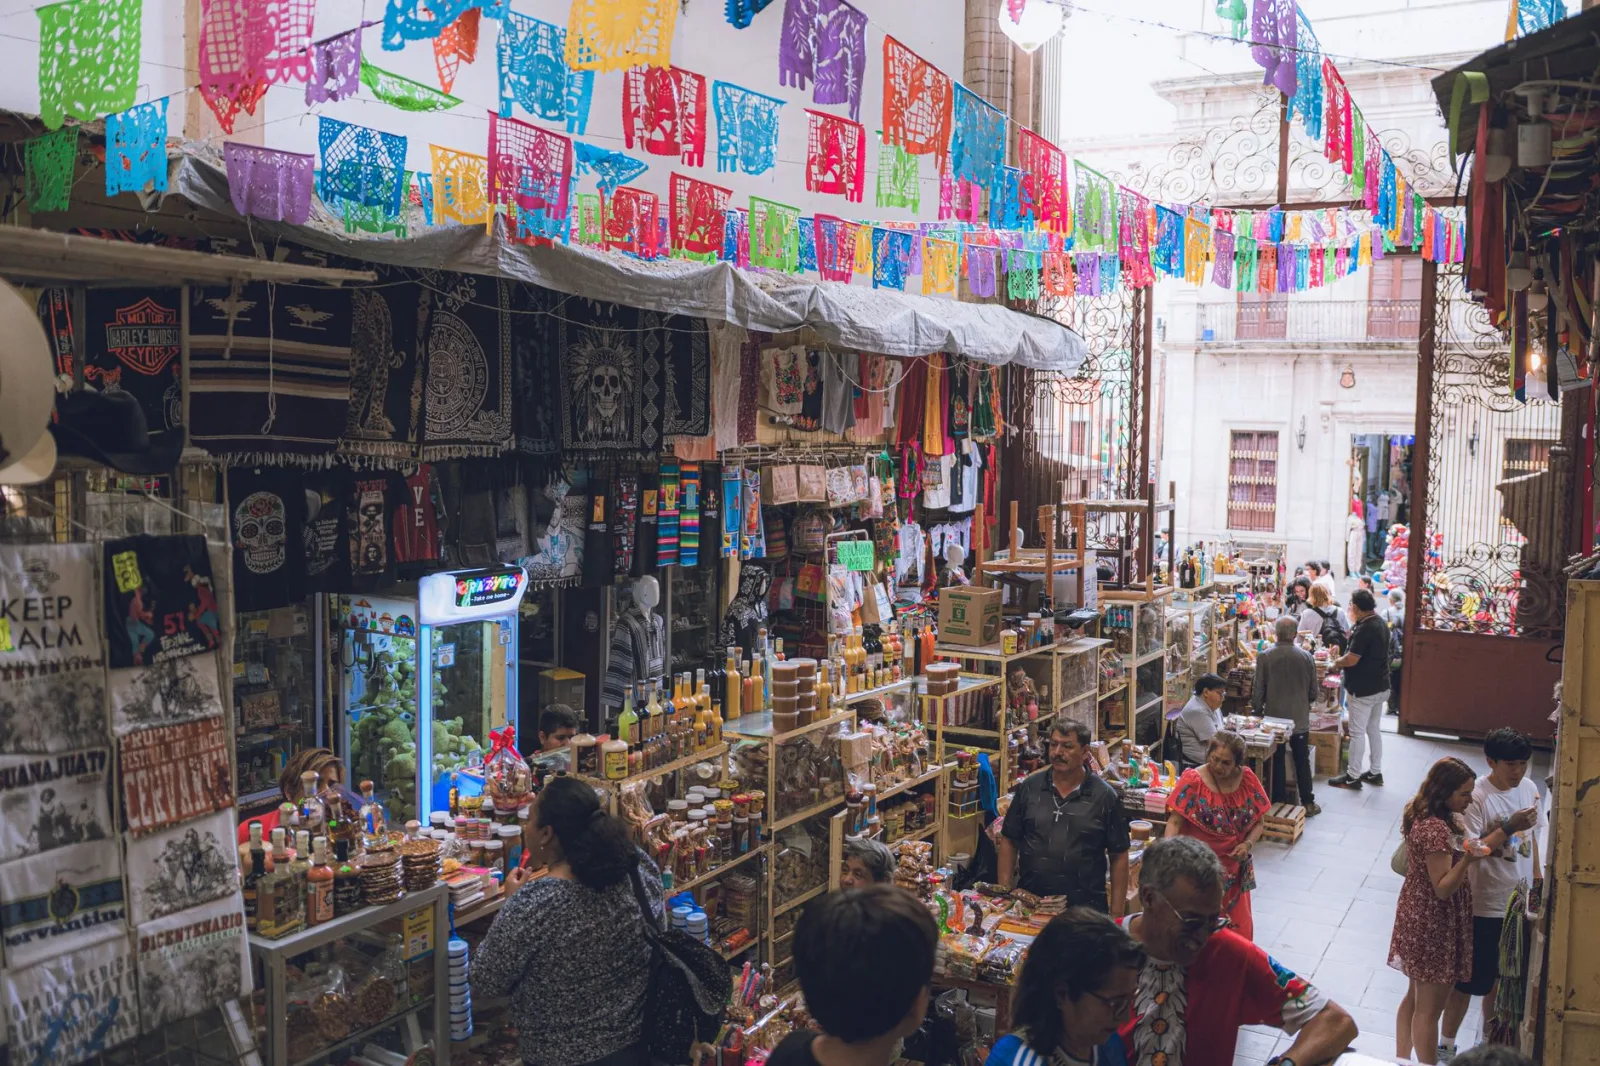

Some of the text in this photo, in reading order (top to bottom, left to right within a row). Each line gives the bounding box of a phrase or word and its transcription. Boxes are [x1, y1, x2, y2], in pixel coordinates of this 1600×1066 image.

[127, 309, 165, 325] MOTOR
[111, 328, 179, 346] HARLEY-DAVIDSO
[0, 596, 72, 621] KEEP
[163, 610, 187, 635] 51
[19, 621, 83, 650] ALM
[140, 912, 243, 953] BICENTENARIO
